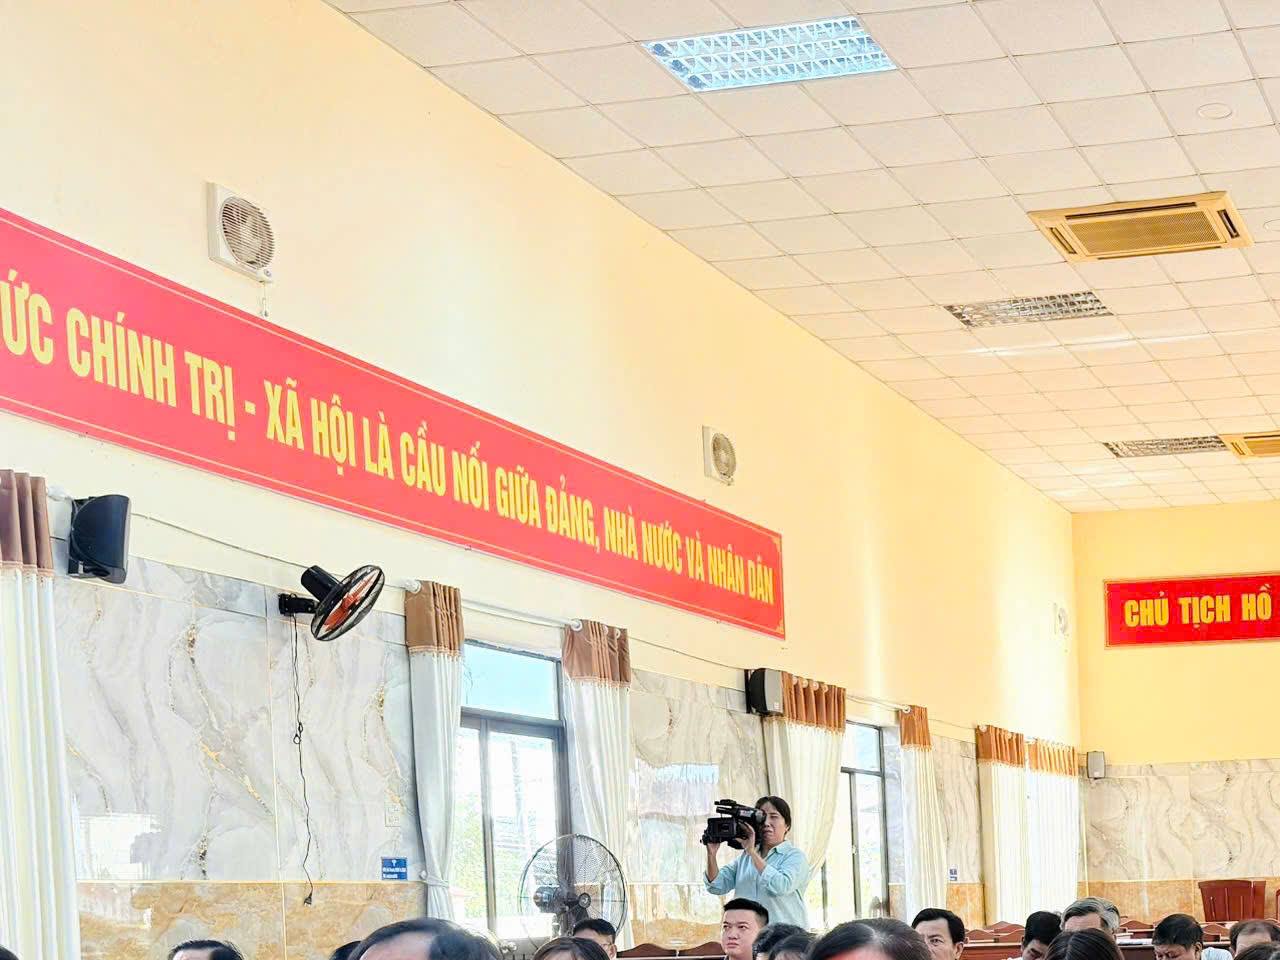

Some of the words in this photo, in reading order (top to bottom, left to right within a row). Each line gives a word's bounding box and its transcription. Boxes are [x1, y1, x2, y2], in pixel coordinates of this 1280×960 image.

[66, 307, 177, 408] CHÍNH
[184, 350, 236, 441] TRỊ
[264, 376, 304, 451] XÃ
[311, 394, 357, 476] HỘI
[363, 410, 395, 481] LÀ
[400, 420, 447, 497] CẦU
[451, 440, 489, 512] NỐI
[495, 465, 542, 529] GIỮA
[546, 474, 600, 554] ĐẢNG,
[604, 506, 638, 561] NHÀ
[642, 520, 682, 575] NƯỚC
[686, 531, 704, 583] VÀ
[708, 543, 745, 595] NHÂN
[748, 556, 774, 604] DÂN
[1124, 590, 1169, 628] CHỦ
[1178, 594, 1231, 630] TỊCH
[1241, 583, 1273, 621] HỒ
